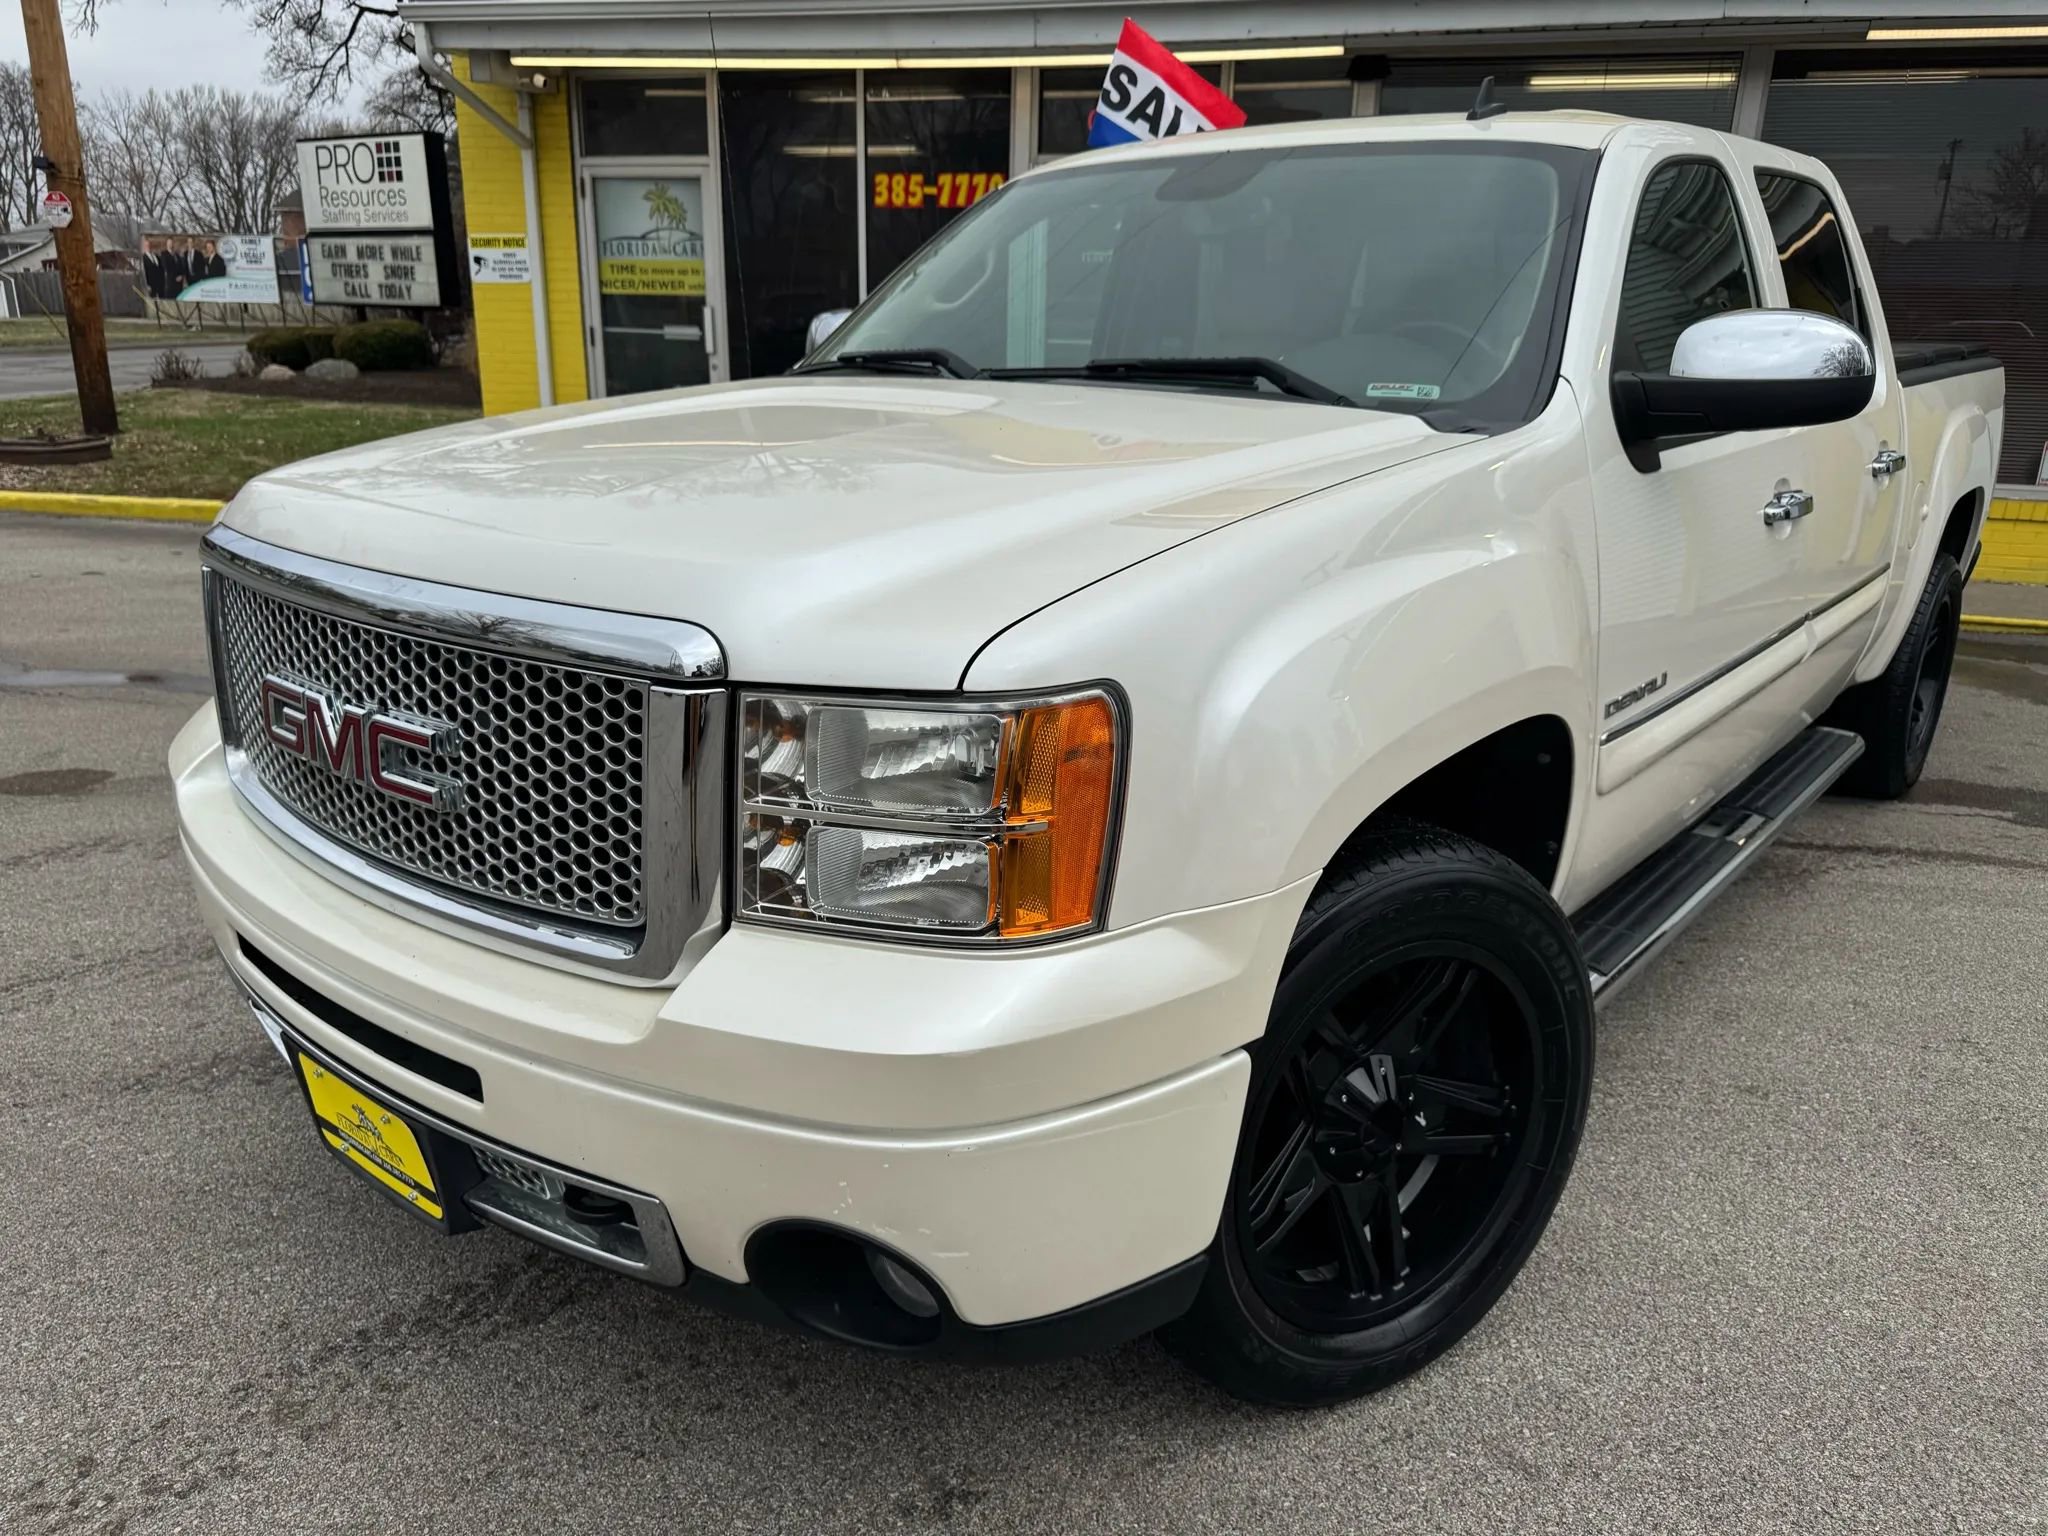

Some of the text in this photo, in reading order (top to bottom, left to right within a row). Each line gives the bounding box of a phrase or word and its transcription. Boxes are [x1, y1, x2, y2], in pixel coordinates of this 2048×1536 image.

[1101, 64, 1205, 139] SAL
[315, 142, 375, 185] PRO
[319, 186, 407, 208] Resources
[322, 208, 409, 226] Staffing Services
[471, 237, 526, 249] SECURITY NOTICE
[602, 241, 658, 257] FLORIDA
[321, 243, 422, 262] EARN MORE WHILE
[331, 263, 416, 281] OTHERS SNORE
[609, 263, 637, 275] TIME
[651, 267, 676, 275] move
[344, 283, 412, 300] CALL TODAY
[601, 279, 686, 291] NICER/NEWER
[1604, 669, 1667, 720] DENALI
[262, 672, 455, 813] GMC
[337, 1116, 376, 1152] FLORIDA
[378, 1144, 402, 1166] CARS
